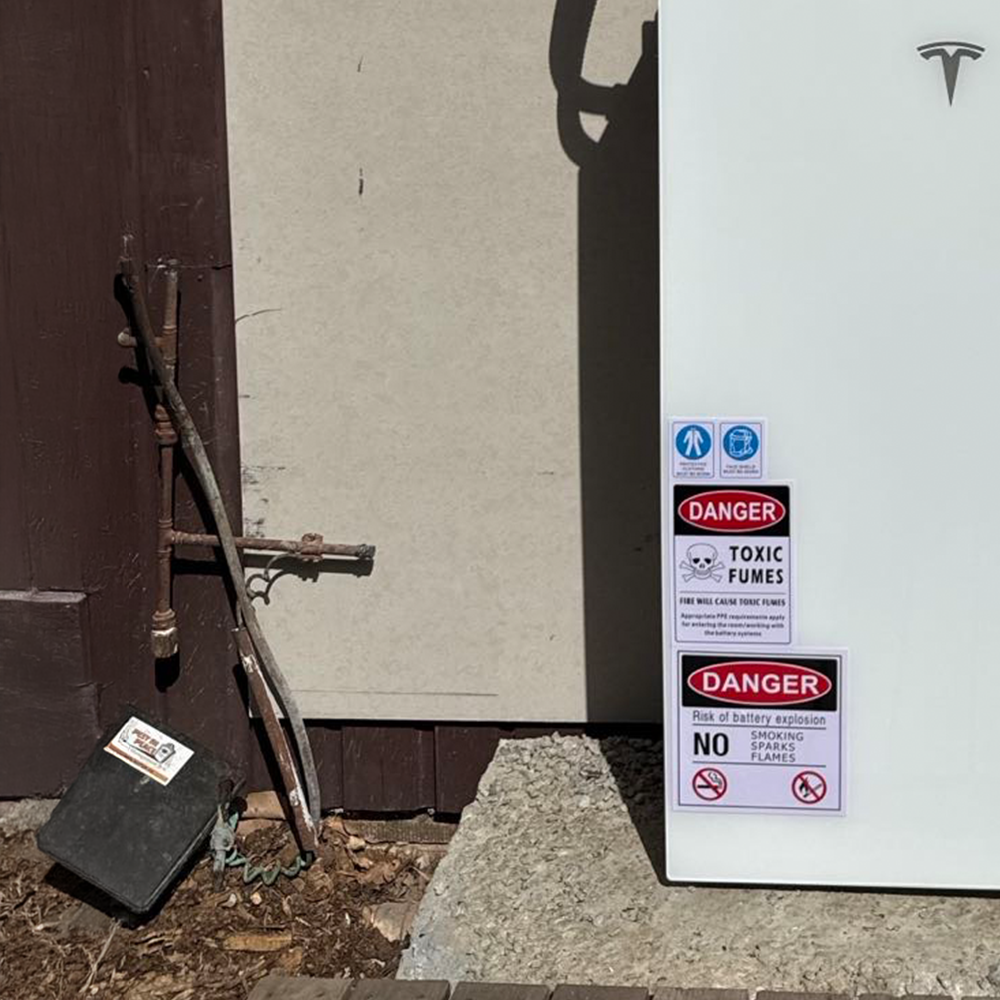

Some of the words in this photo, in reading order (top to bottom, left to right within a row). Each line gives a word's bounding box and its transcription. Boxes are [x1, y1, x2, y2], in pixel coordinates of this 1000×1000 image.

[689, 501, 776, 521] DANGER
[729, 545, 783, 562] TOXIC
[728, 568, 784, 584] FUMES
[679, 597, 695, 605] FIRE
[696, 597, 713, 605] WILL
[715, 598, 737, 606] CAUSE
[739, 598, 760, 606] TOXIC
[762, 598, 786, 606] FUMES
[702, 672, 819, 695] DANGER
[692, 710, 715, 721] Risk
[719, 711, 729, 723] of
[733, 712, 772, 726] battery
[775, 713, 826, 726] explosion
[751, 730, 804, 742] SMOKING
[693, 732, 729, 757] NO
[751, 741, 796, 752] SPARKS
[751, 752, 796, 763] FLAMES
